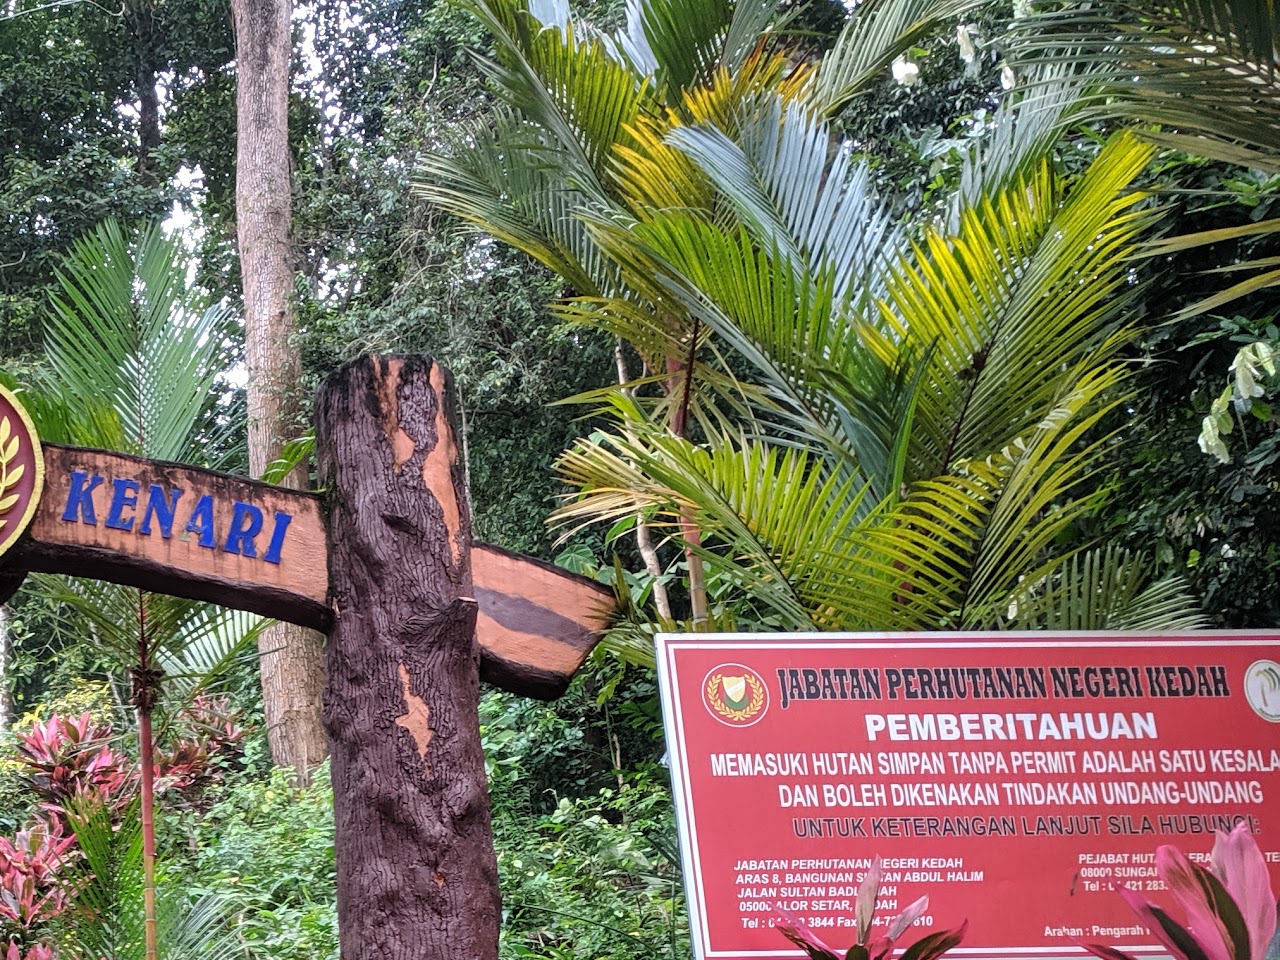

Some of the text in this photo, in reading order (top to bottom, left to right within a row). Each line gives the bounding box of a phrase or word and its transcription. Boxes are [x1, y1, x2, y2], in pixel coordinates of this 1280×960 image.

[61, 471, 293, 565] KENARI
[776, 665, 1231, 709] JABATAN PERHUTANAN NEGERI KEDAH
[864, 712, 1159, 741] PEMBERITAHUAN
[710, 753, 809, 776] MEMASUKI
[812, 753, 874, 775] HUTAN
[877, 752, 946, 775] SIMPAN
[948, 751, 1011, 774] TANPA
[1011, 751, 1077, 774] PERMIT
[1082, 751, 1156, 773] ADALAH
[1159, 750, 1207, 773] SATU
[778, 780, 1264, 807] DAN BOLEH DIKENAKAN TINDAKAN UNDANG-UNDANG
[793, 817, 870, 838] UNTUK
[871, 816, 1018, 838] KETERANGAN
[1019, 815, 1102, 836] LANJUT
[1107, 815, 1156, 836] SILA
[734, 860, 789, 870] JABATAN
[791, 859, 872, 870] PERHUTANAN
[922, 858, 963, 868] KEDAH
[1078, 853, 1130, 864] PEJABAT
[1132, 853, 1157, 864] HUT
[1114, 866, 1158, 877] SUNGAI
[735, 871, 984, 886] ARAS 8, BANGUNAN SAN ABDUL HALIM
[1083, 881, 1099, 891] Tel
[1145, 880, 1169, 890] 283
[737, 887, 777, 898] JALAN
[780, 887, 826, 897] SULTAN
[776, 900, 808, 911] ALOR
[811, 900, 853, 912] SETAR,
[741, 917, 759, 928] Tel
[808, 917, 835, 928] 3844
[837, 916, 857, 927] Fax
[1044, 925, 1083, 937] Arahan
[1092, 925, 1144, 938] Pengarah
